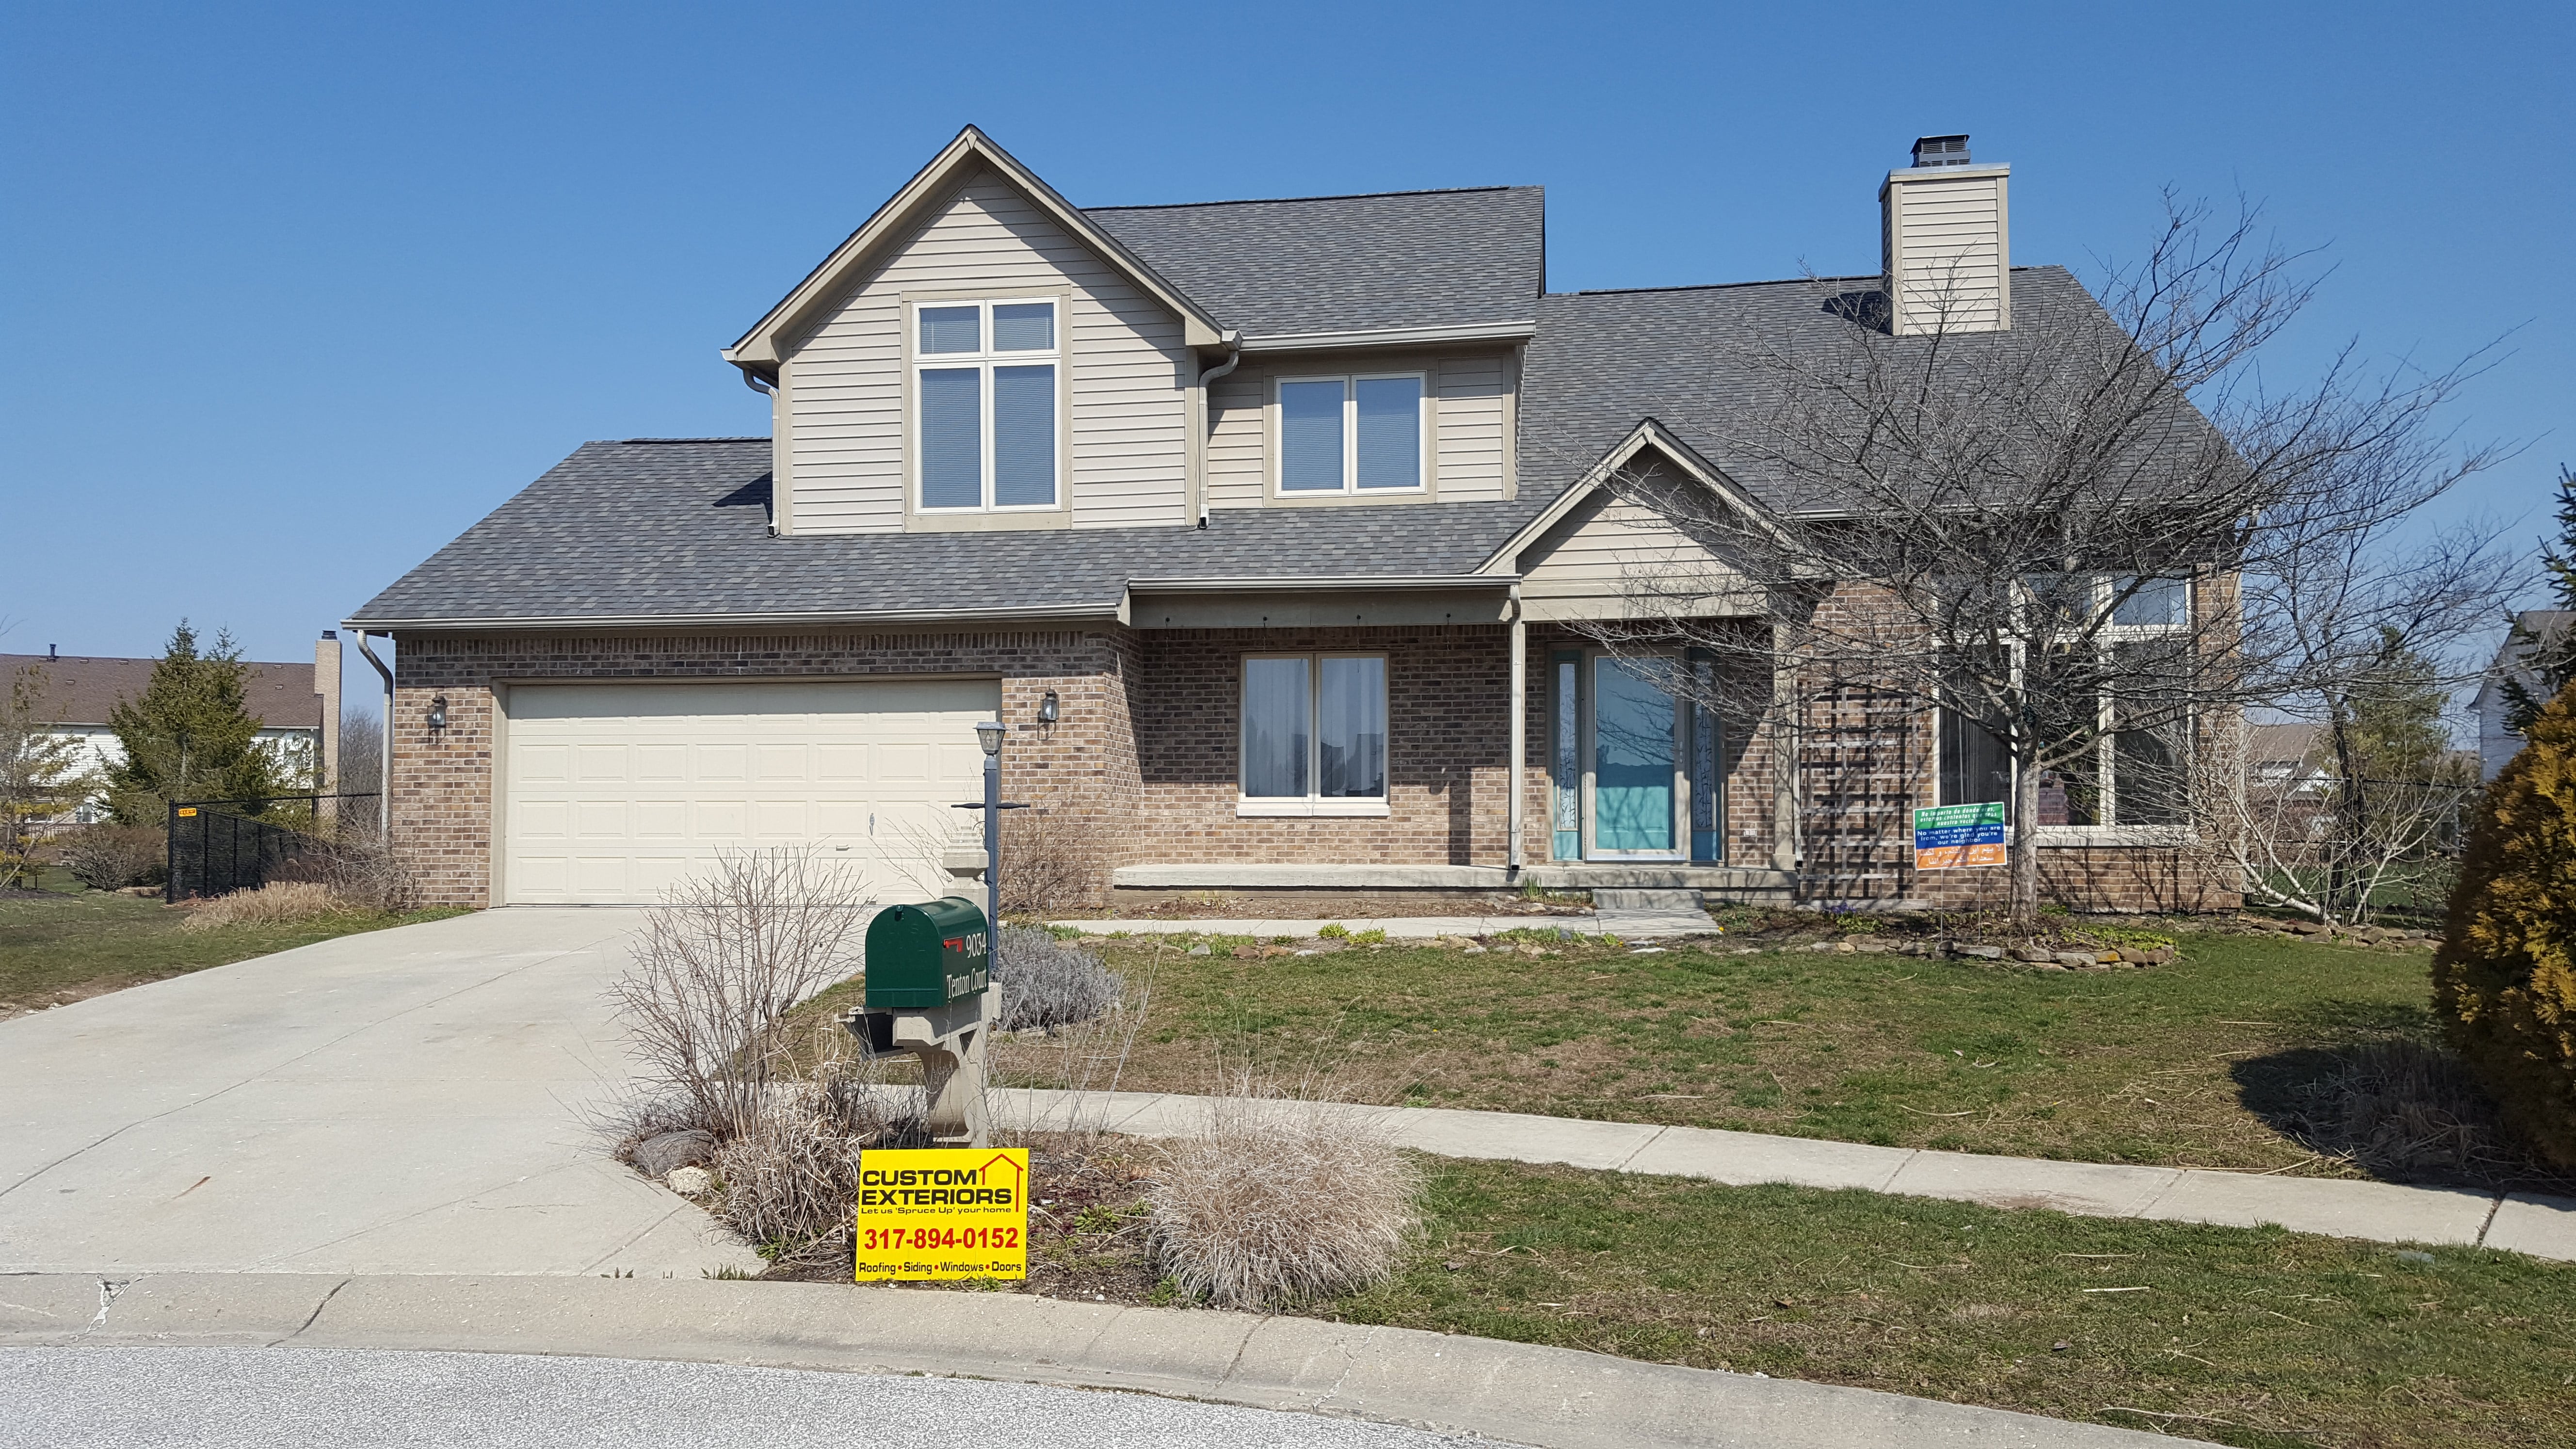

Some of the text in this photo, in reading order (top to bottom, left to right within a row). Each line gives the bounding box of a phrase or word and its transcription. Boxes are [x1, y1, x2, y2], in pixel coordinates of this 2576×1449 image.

[966, 931, 987, 958] 9034
[947, 966, 987, 999] Tenton Court
[862, 1169, 977, 1186] CUSTOM
[861, 1188, 1012, 1206] EXTERIORS
[895, 1207, 935, 1215] 'Spruce
[938, 1207, 955, 1215] Up'
[864, 1227, 1018, 1250] 317-894-0152
[859, 1261, 1021, 1275] Roofing Siding Windows Doors
